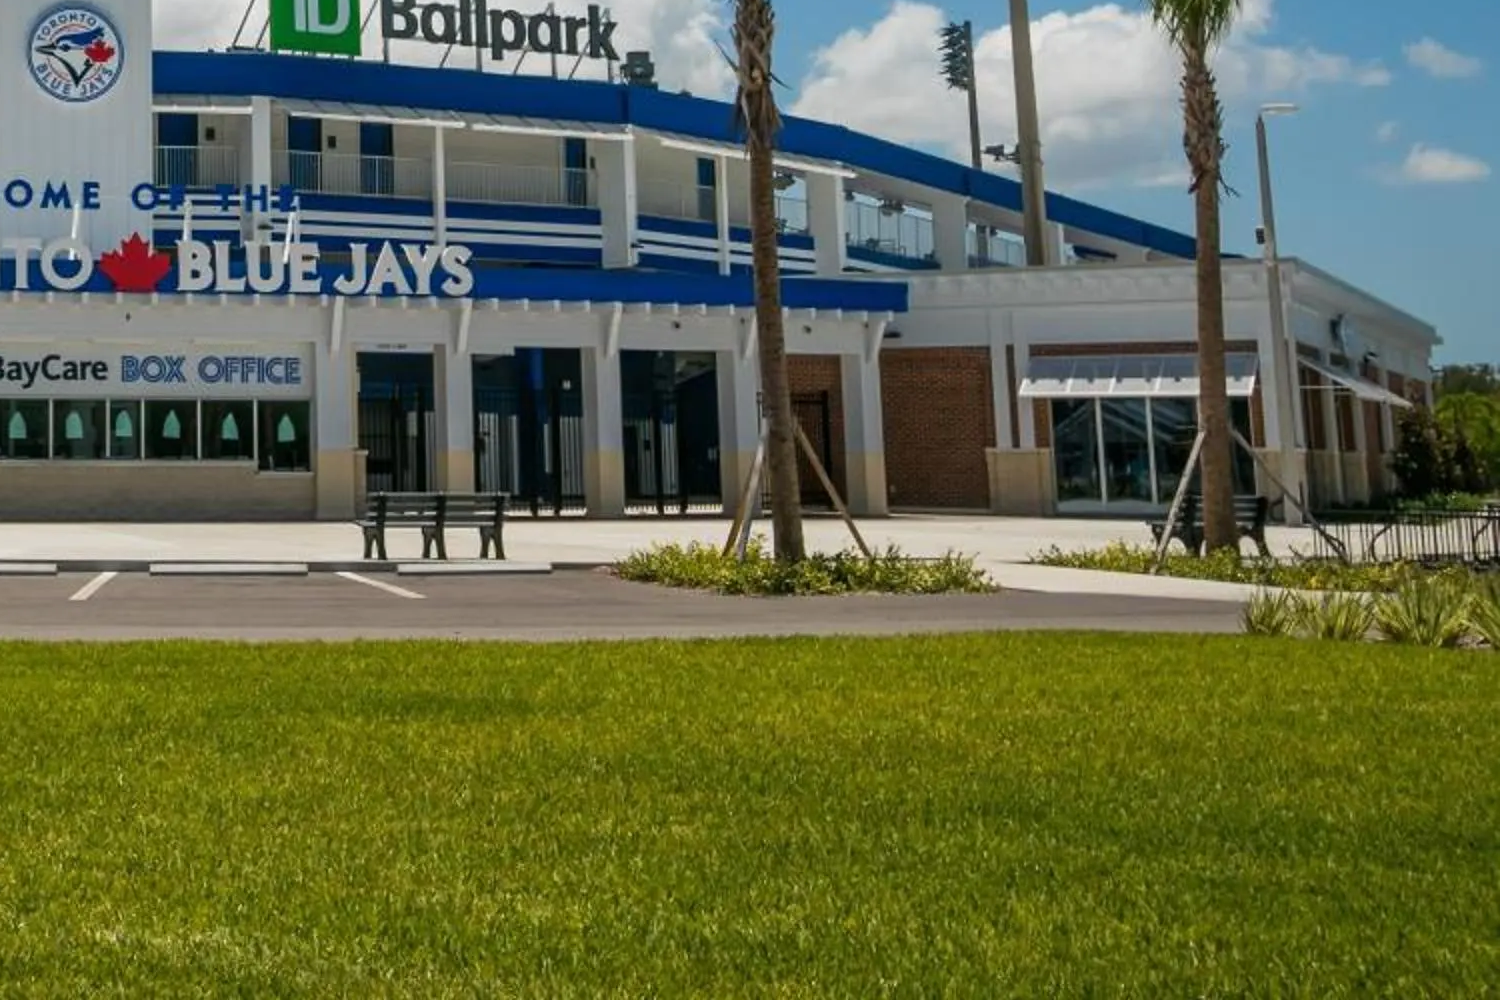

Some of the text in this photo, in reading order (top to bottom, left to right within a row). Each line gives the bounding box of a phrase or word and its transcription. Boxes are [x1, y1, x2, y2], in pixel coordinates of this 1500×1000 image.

[36, 12, 98, 42] TORONTO
[36, 62, 114, 96] BLUE JAYS
[131, 182, 185, 212] OF
[215, 183, 299, 213] THE
[175, 239, 323, 293] BLUE
[332, 239, 475, 298] JAYS
[121, 354, 188, 384] BOX
[198, 355, 303, 385] OFFICE
